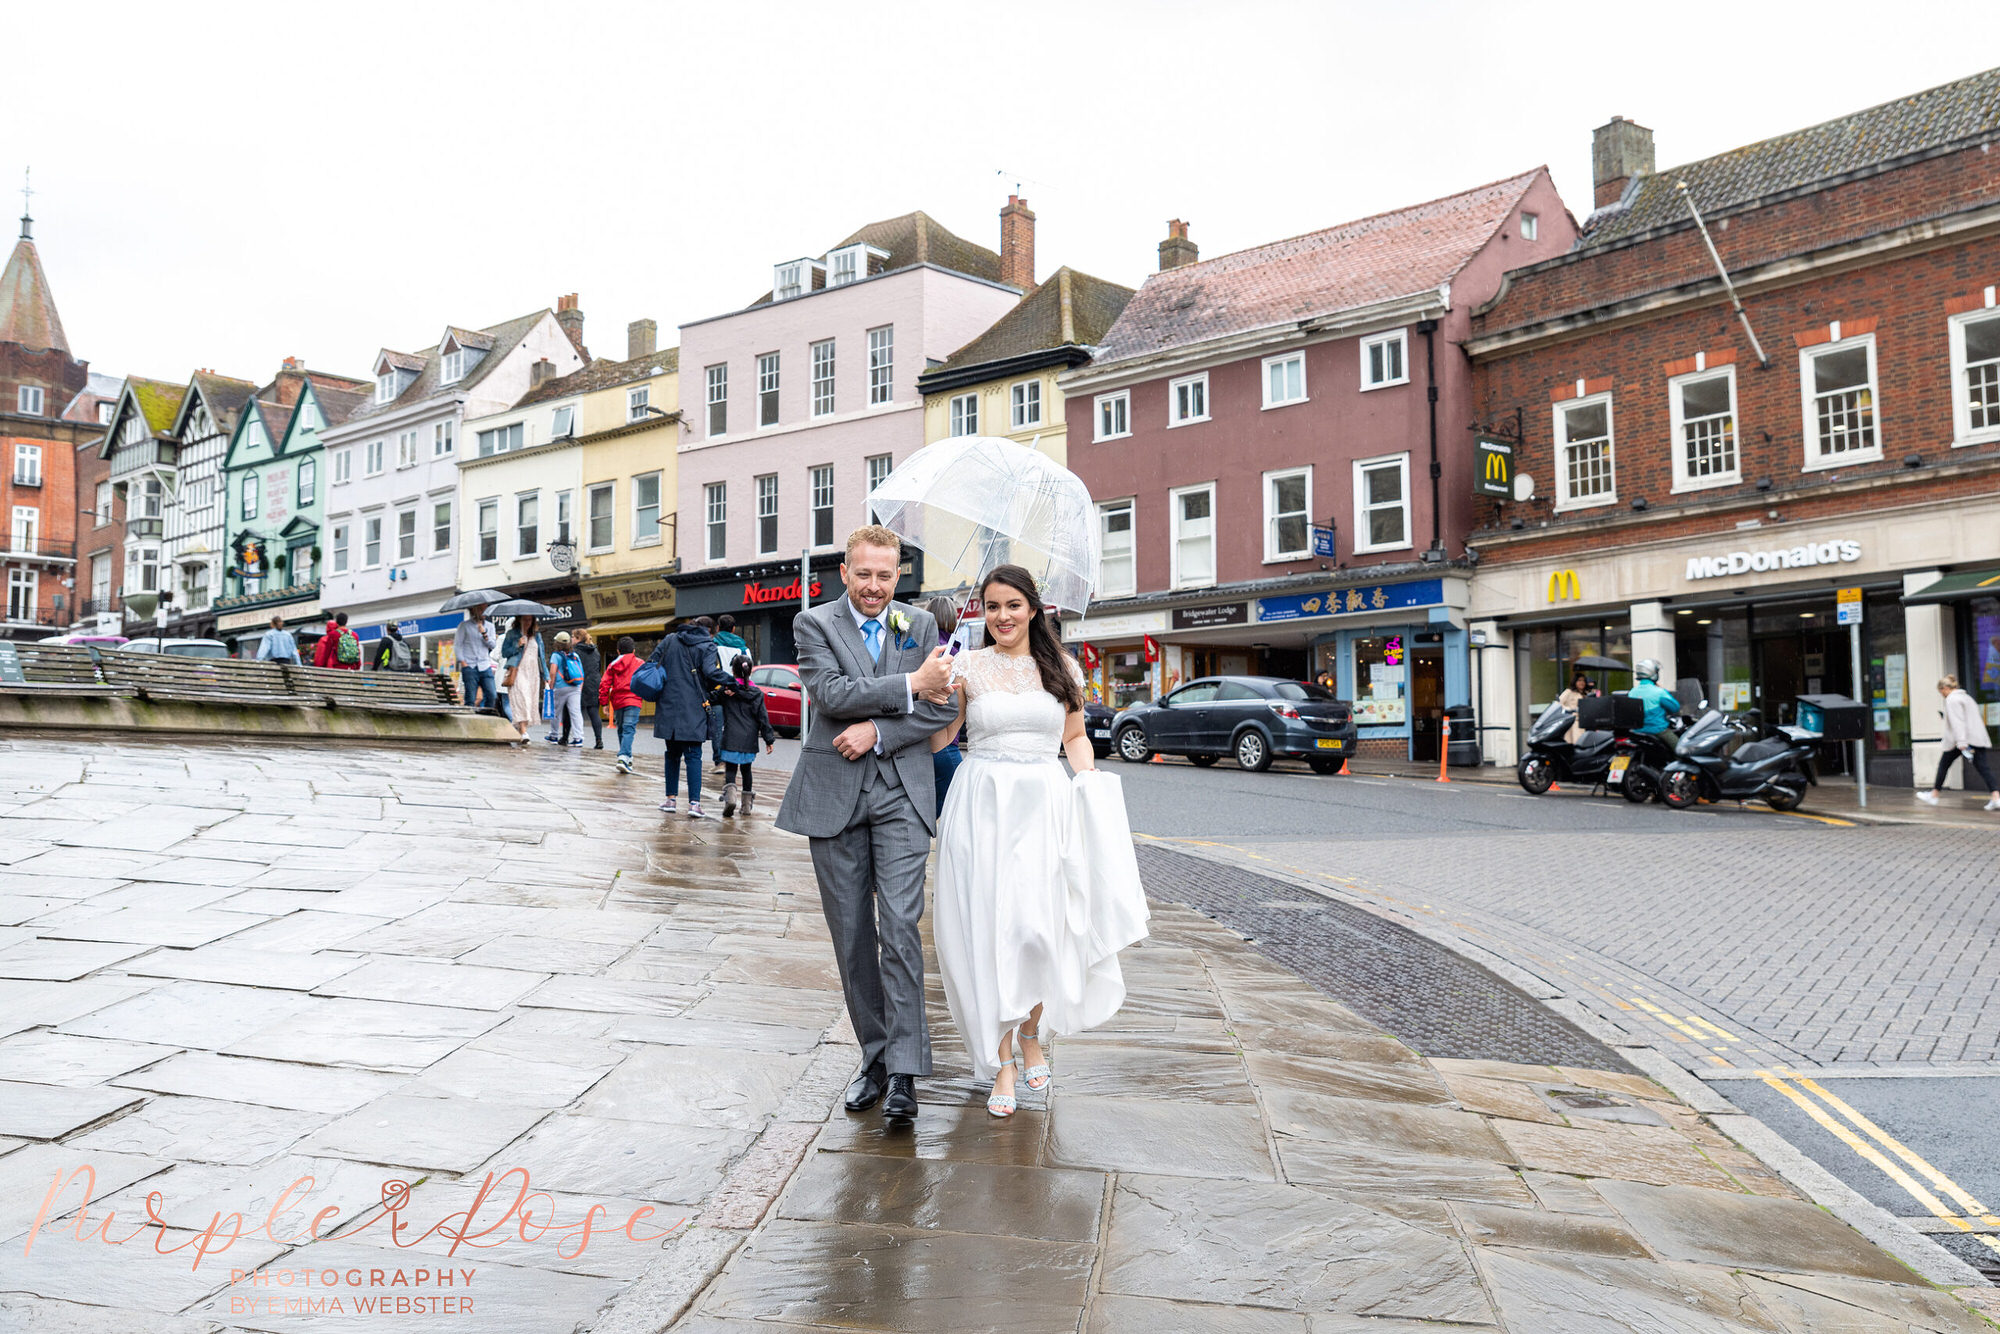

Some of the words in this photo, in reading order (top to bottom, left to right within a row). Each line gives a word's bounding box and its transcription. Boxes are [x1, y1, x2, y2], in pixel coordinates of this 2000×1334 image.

[1684, 539, 1862, 581] McDonald's
[591, 591, 619, 609] Thai
[621, 587, 671, 605] Terrace
[1182, 608, 1217, 619] Bridgewater
[1218, 606, 1237, 615] Lodge
